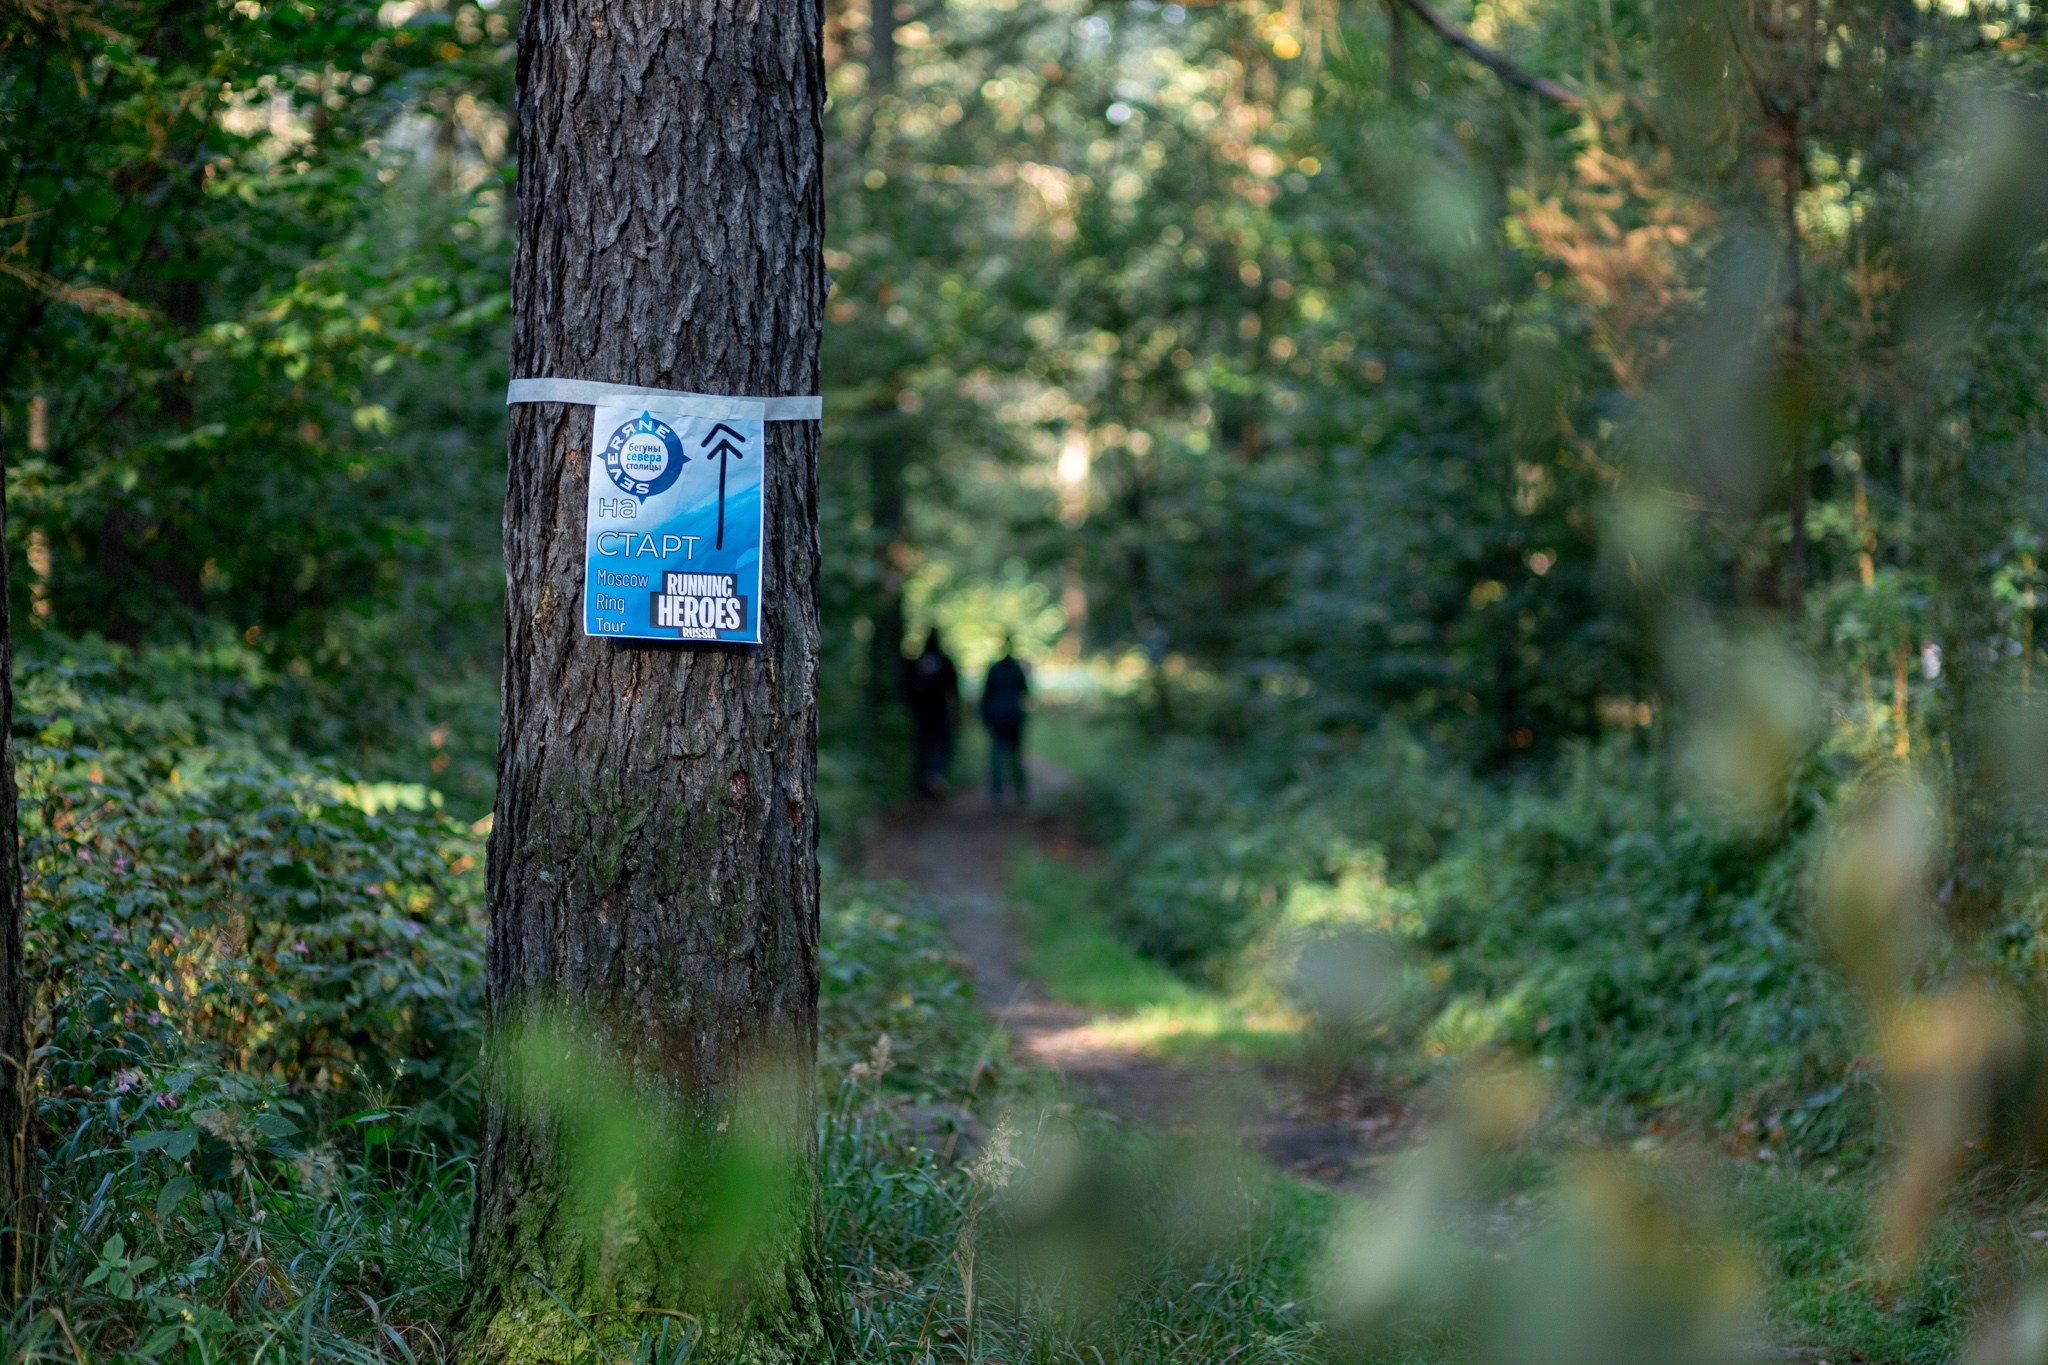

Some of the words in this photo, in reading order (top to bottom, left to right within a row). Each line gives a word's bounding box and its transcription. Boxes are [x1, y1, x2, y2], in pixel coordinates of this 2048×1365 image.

[628, 443, 661, 454] бегуны
[626, 453, 662, 464] севера
[625, 463, 662, 472] столицы
[596, 531, 701, 560] СТАРТ
[596, 569, 649, 588] Moscow
[667, 573, 733, 597] RUNNING
[596, 593, 625, 615] Ring
[658, 595, 741, 630] HEROES
[595, 617, 626, 632] Tour
[682, 627, 717, 639] RUSSIA
